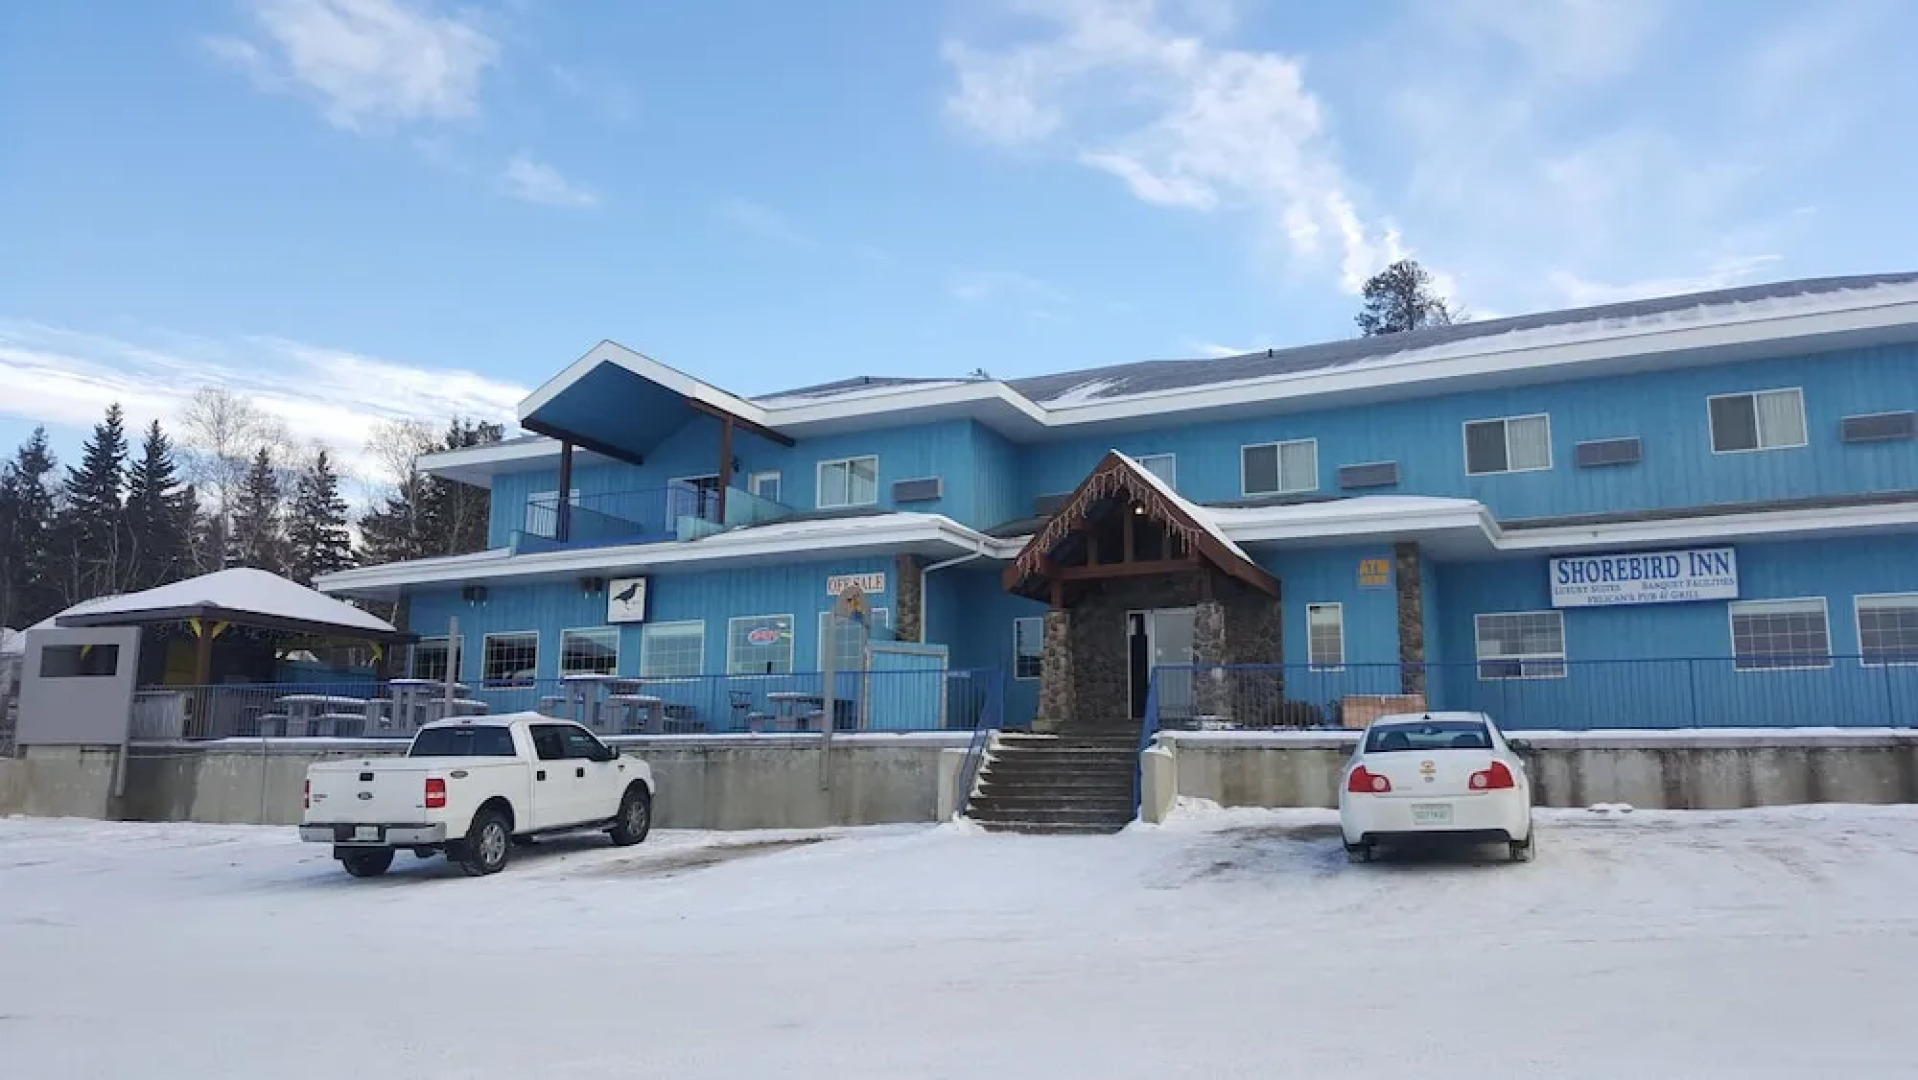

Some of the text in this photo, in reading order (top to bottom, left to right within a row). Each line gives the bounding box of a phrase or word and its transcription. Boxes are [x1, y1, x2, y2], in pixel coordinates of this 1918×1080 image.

[1557, 551, 1730, 584] SHOREBIRD INN
[1641, 580, 1685, 590] BANQUET
